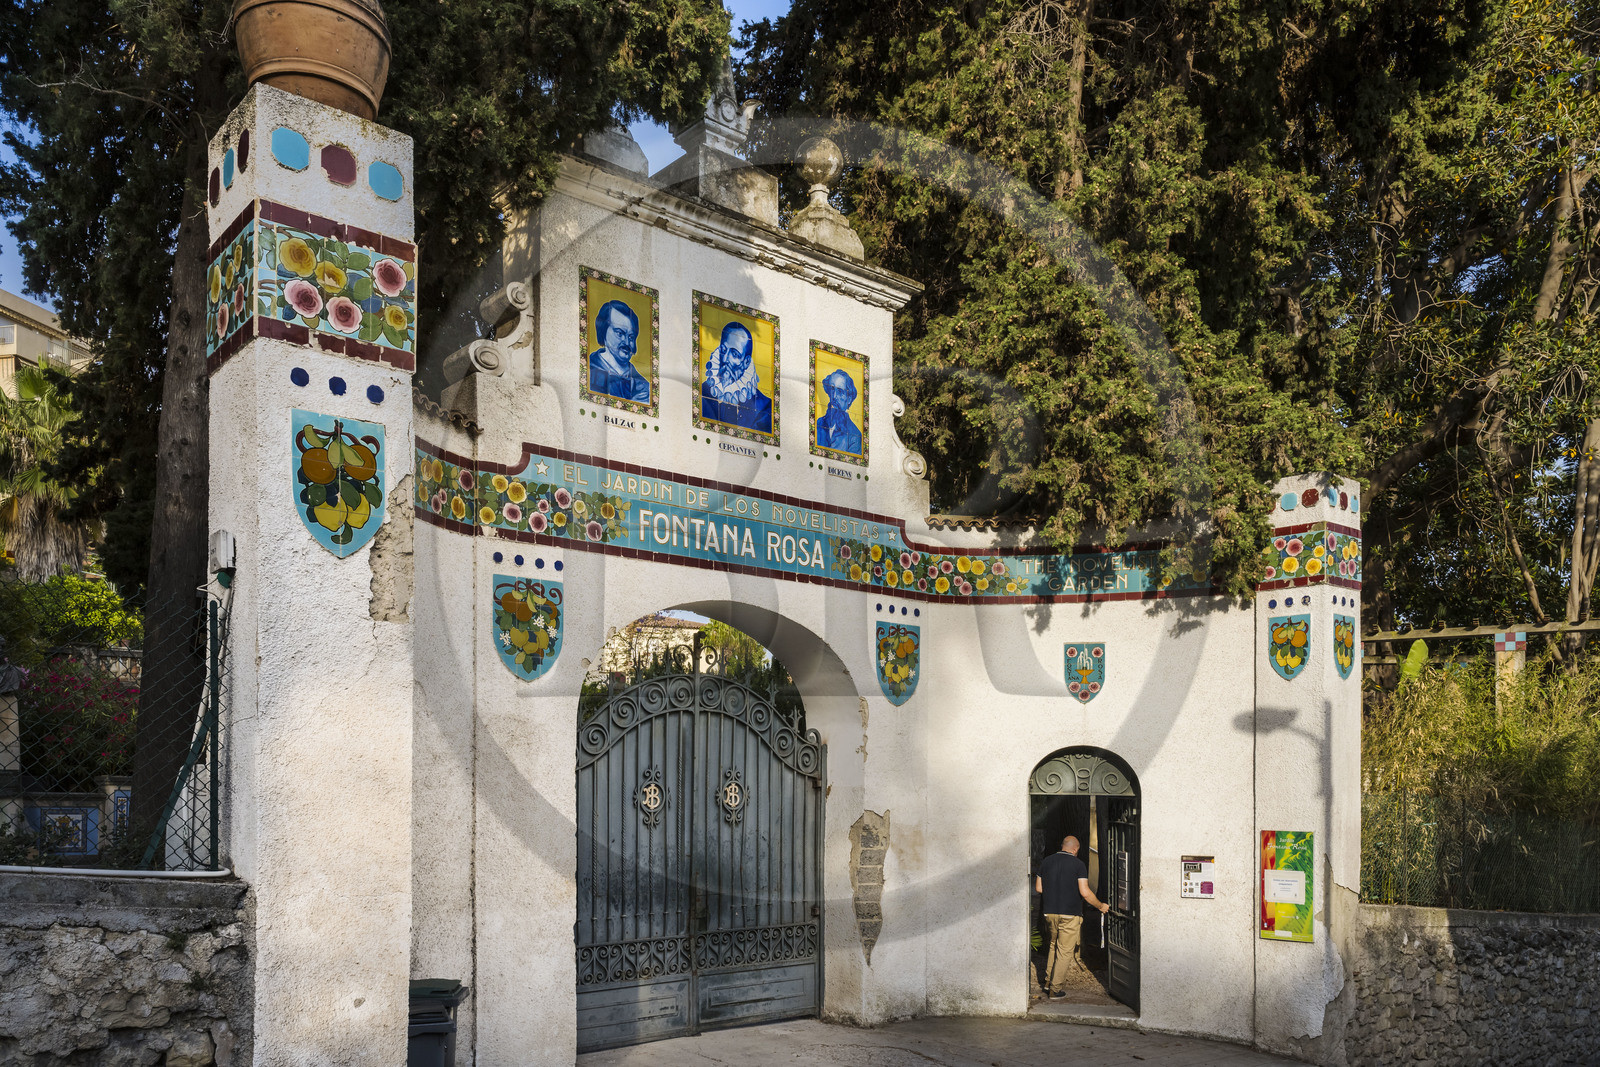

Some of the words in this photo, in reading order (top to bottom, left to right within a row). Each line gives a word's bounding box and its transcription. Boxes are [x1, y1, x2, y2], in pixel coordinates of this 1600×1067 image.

[604, 415, 636, 429] BALZAC
[718, 442, 757, 457] CERVANTES
[828, 466, 852, 478] DICKENS
[563, 463, 589, 486] EL
[601, 473, 673, 502] JARDIN
[686, 488, 709, 509] DE
[723, 494, 761, 518] LOS
[772, 504, 880, 540] NOVELISTAS
[638, 508, 757, 560] FONTANA
[766, 530, 825, 570] ROSA
[1021, 558, 1056, 575] THE
[1048, 574, 1129, 592] GARDEN
